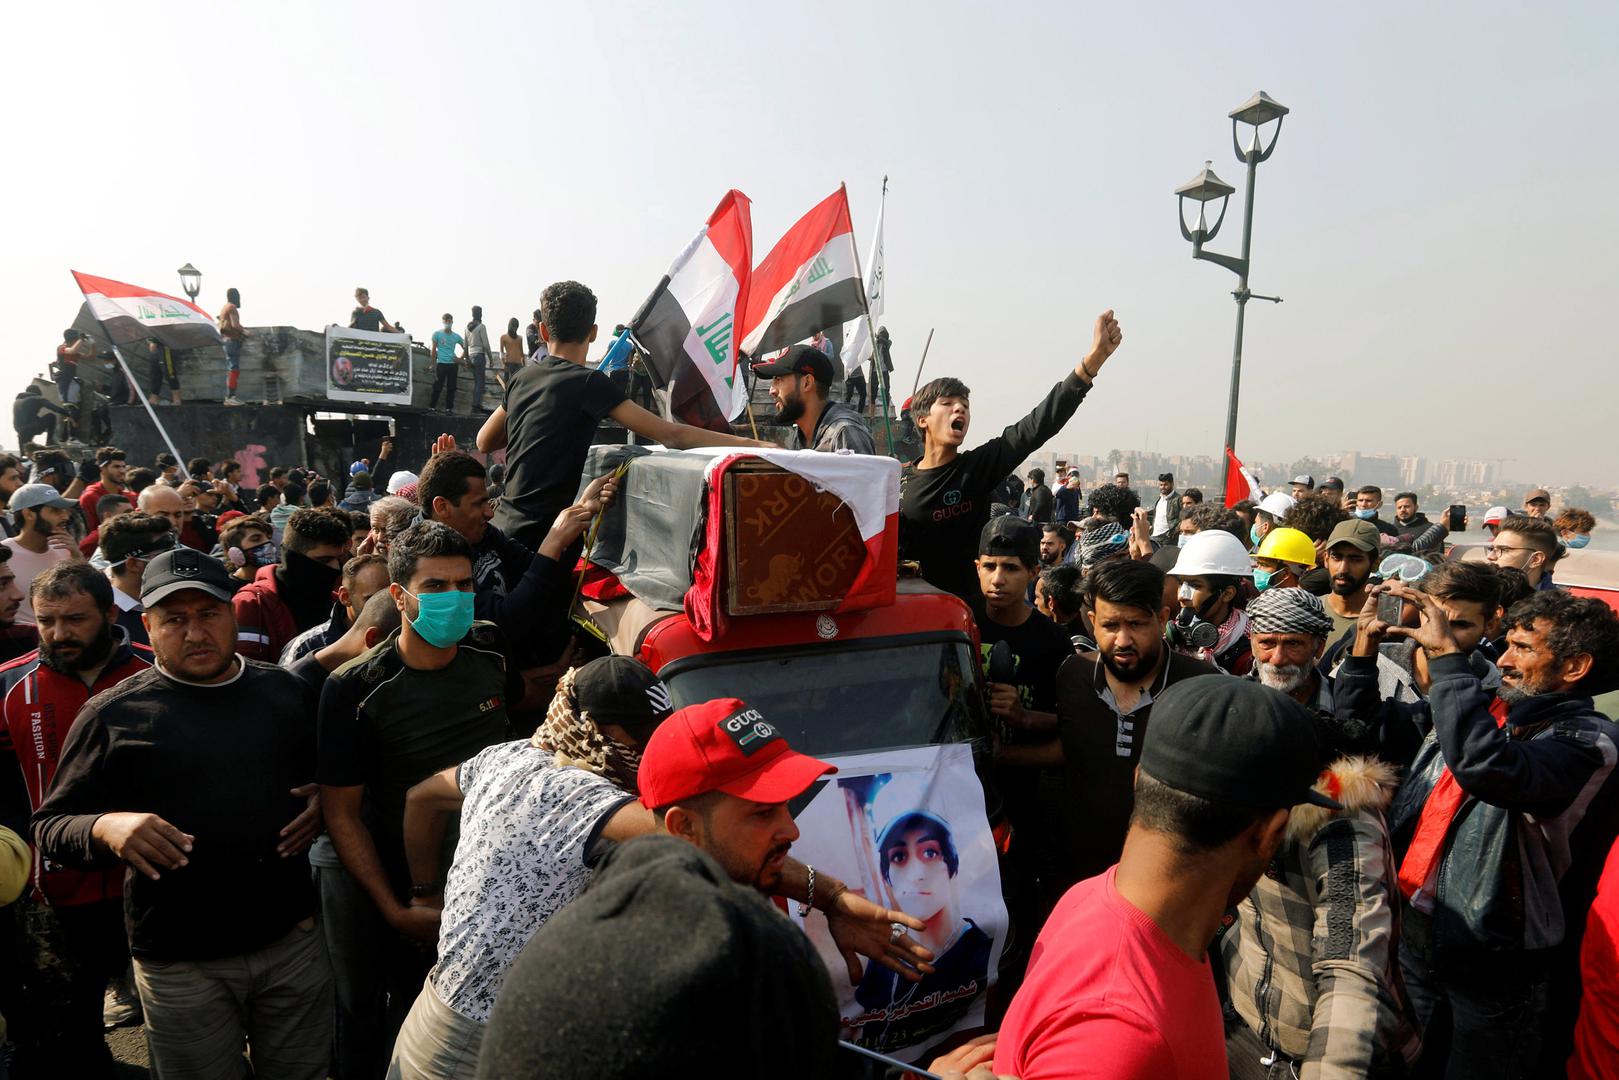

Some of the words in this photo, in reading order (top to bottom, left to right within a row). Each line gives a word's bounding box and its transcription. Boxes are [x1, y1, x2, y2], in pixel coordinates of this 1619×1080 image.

[744, 476, 806, 537] ORK
[932, 499, 973, 522] GUCCI
[31, 711, 46, 760] FASHION
[888, 991, 941, 1021] التحرير
[941, 979, 978, 1004] شهيد
